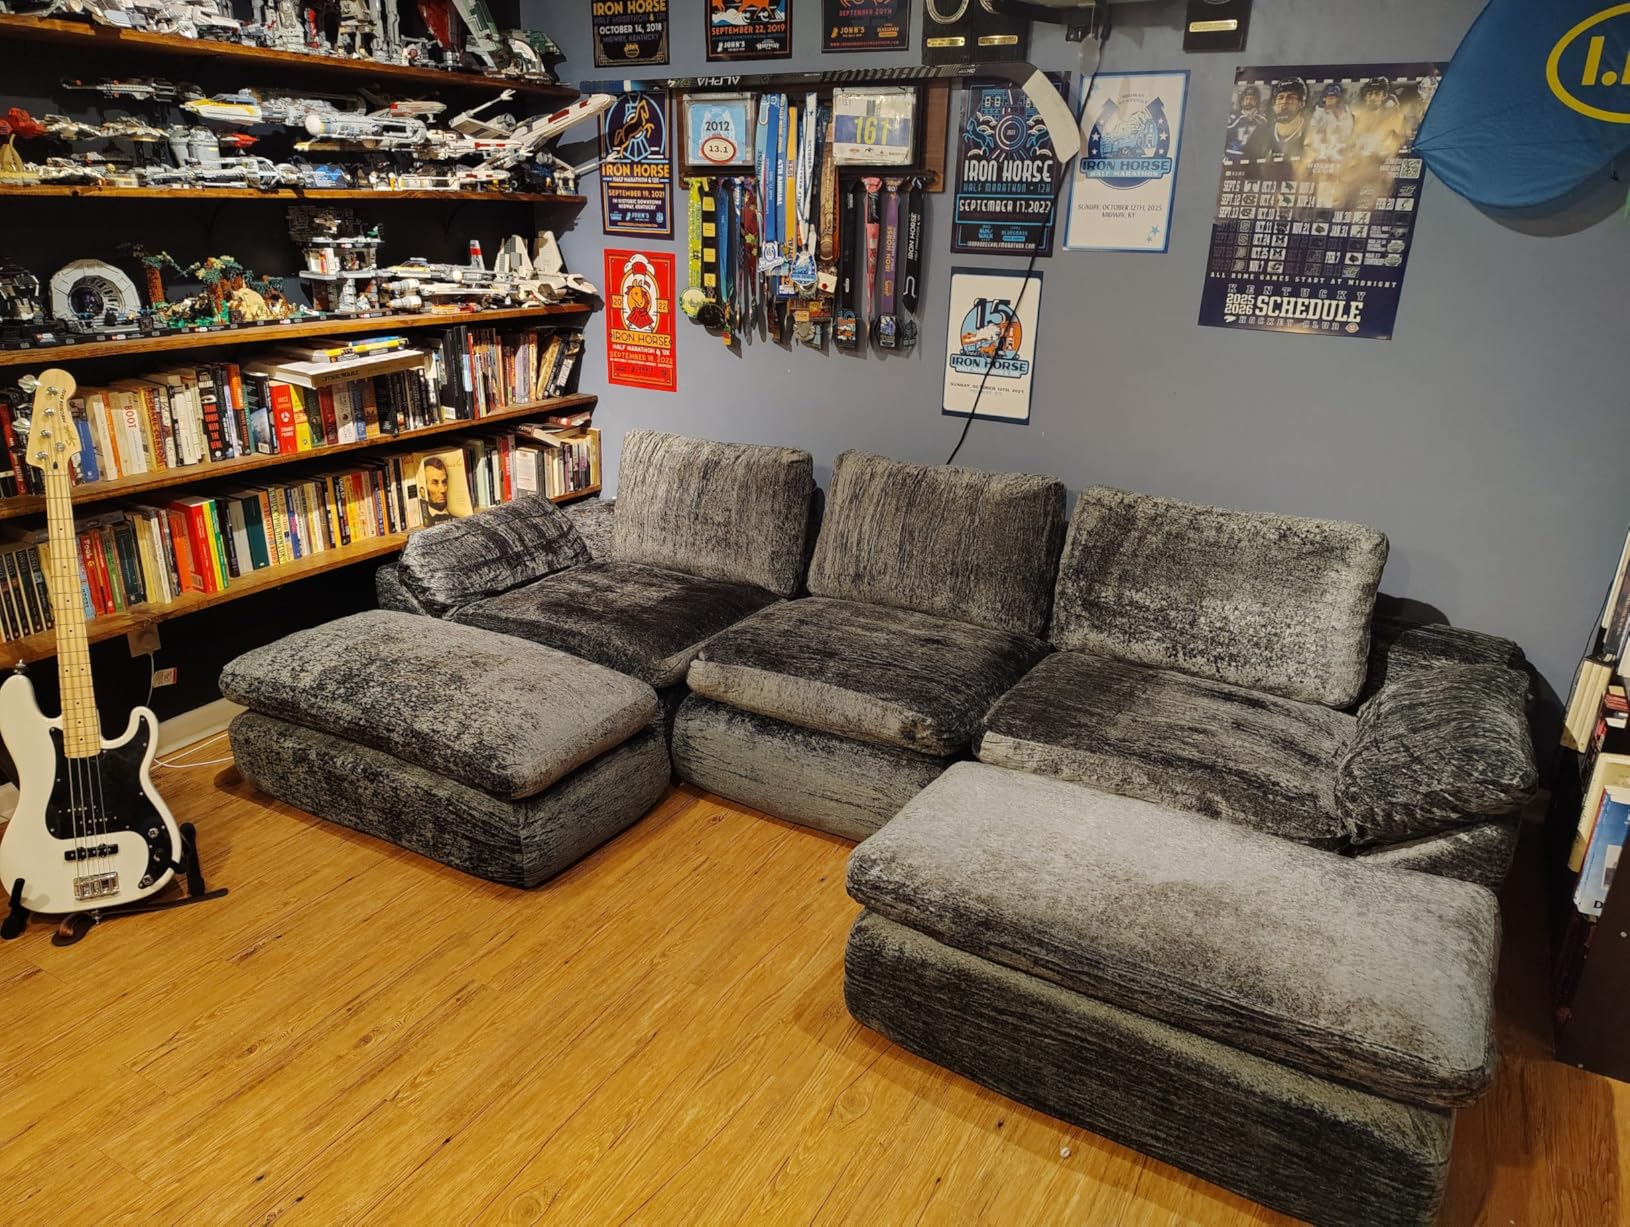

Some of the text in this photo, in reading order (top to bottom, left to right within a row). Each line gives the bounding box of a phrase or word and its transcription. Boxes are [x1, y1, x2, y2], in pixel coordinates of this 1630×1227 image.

[593, 0, 667, 16] IRON HORSE
[599, 25, 633, 35] OCTOBER
[646, 23, 663, 32] 2018
[711, 26, 753, 36] SEPTEMBER
[767, 24, 786, 32] 2019
[840, 26, 865, 34] JOHN'S
[697, 76, 740, 86] ALPHA
[705, 121, 730, 131] 2012
[854, 116, 889, 145] 161
[708, 145, 729, 153] 13.1
[602, 164, 669, 177] IRON HORSE
[963, 159, 1053, 182] IRON HORSE
[1082, 160, 1169, 170] IRON HORSE
[608, 189, 641, 197] SEPTEMBER
[963, 183, 982, 192] HALF
[984, 183, 1026, 192] MARATHON
[960, 200, 1013, 212] SEPTEMBER
[909, 212, 917, 239] HORSE
[886, 224, 894, 252] HORSE
[1259, 274, 1289, 282] GAMES
[1294, 276, 1325, 284] START
[1347, 279, 1398, 288] MIDNIGHT
[1227, 283, 1367, 301] KENTUCKY
[613, 298, 621, 306] 20
[659, 302, 666, 310] 22
[1226, 293, 1364, 323] 2025 SCHEDULE
[974, 297, 1011, 329] 15
[1224, 303, 1254, 315] 2026
[1238, 316, 1340, 331] HOCKEY CLUB
[613, 331, 669, 346] IRON HORSE
[610, 351, 646, 360] SEPTEMBER
[952, 356, 980, 367] IRON
[124, 405, 137, 428] BOOT
[153, 428, 165, 464] CHABON
